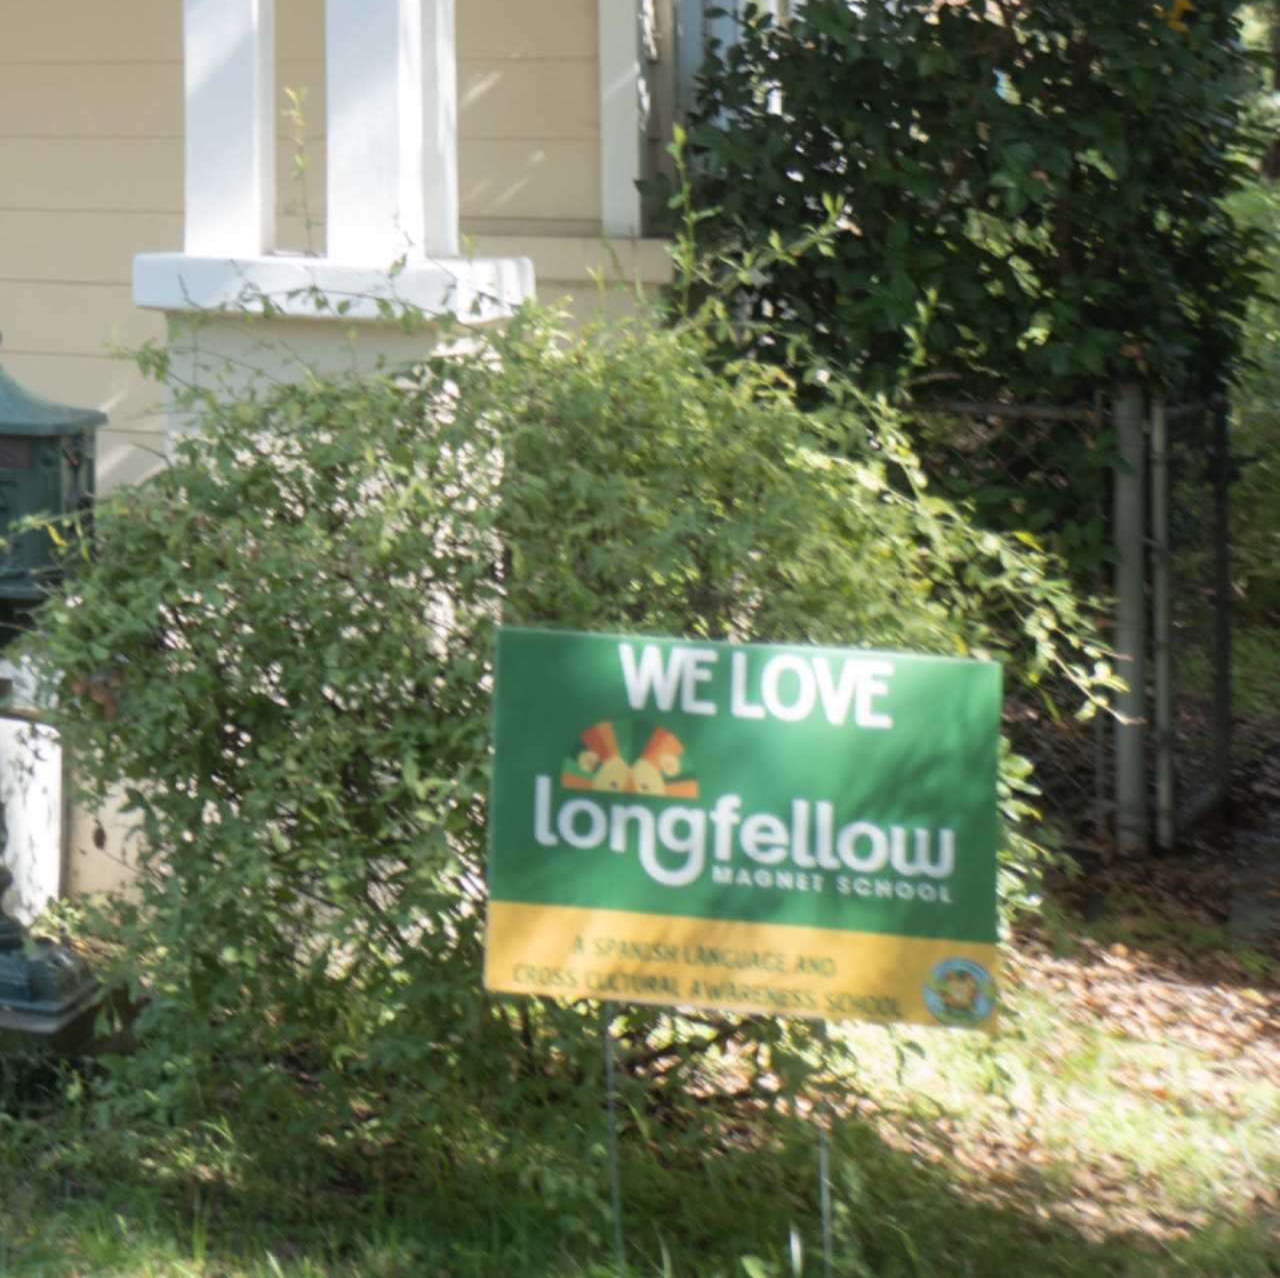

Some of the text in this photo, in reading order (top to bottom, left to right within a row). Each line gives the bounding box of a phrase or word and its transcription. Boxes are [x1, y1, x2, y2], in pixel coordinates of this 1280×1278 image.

[618, 643, 894, 729] WE LOVE
[534, 775, 955, 887] longfellow
[711, 865, 953, 905] MAGNET SCHOOL
[592, 937, 680, 964] SPANISH
[684, 945, 789, 973] LANGUAGE
[796, 955, 838, 978] AND
